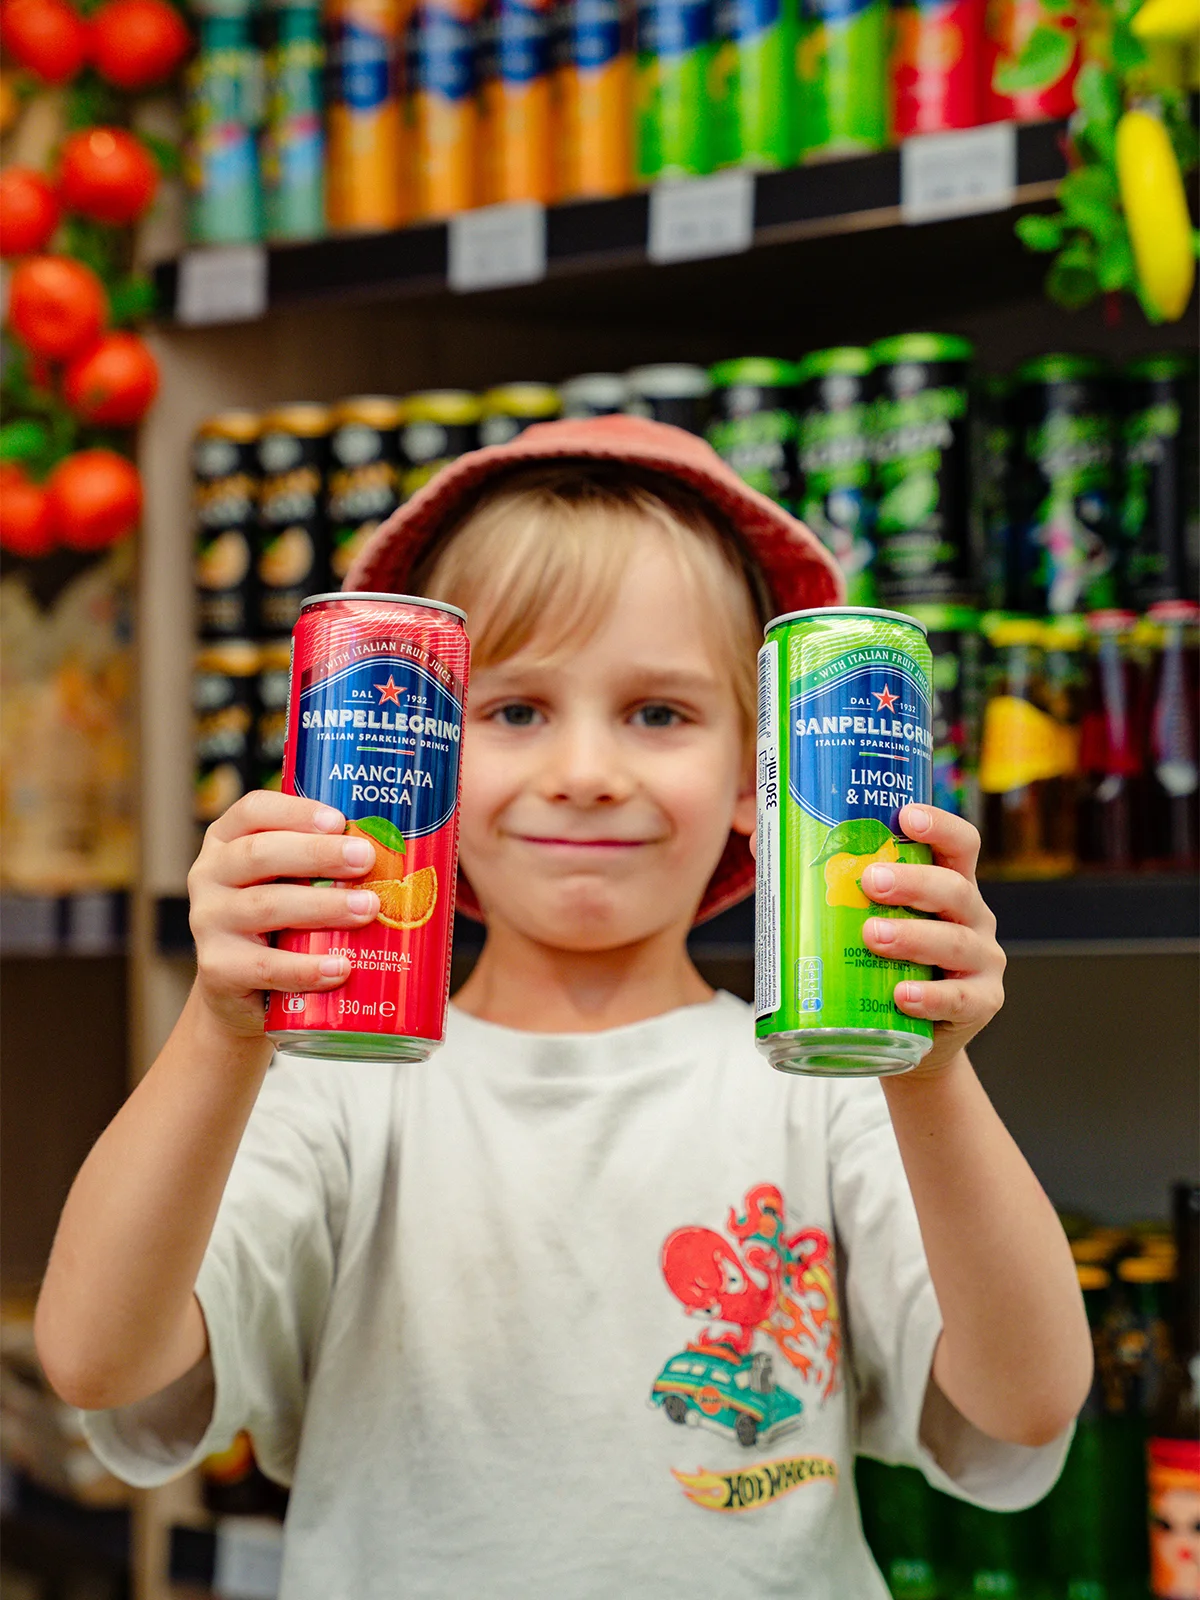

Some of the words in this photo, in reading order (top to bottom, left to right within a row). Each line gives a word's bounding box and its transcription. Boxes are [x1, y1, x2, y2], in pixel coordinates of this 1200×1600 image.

[324, 653, 351, 671] WITH
[352, 641, 397, 658] ITALIAN
[400, 644, 430, 663] FRUIT
[428, 657, 452, 685] JUICE
[819, 660, 846, 680] WITH
[847, 650, 889, 666] ITALIAN
[891, 653, 916, 672] FRUIT
[351, 688, 373, 698] DAL
[406, 694, 428, 705] 1932
[850, 697, 871, 705] DAL
[899, 702, 916, 713] 1932
[302, 709, 461, 743] SANPELLEGRINO
[795, 716, 933, 751] SANPELLEGRIN
[317, 732, 354, 741] ITALIAN
[359, 733, 416, 746] SPARKLING
[420, 740, 450, 753] DRINKS
[815, 738, 855, 747] ITALIAN
[860, 739, 910, 753] SPARKLING
[328, 763, 434, 789] ARANCIATA
[765, 761, 777, 780] ml
[850, 768, 914, 792] LIMONE
[351, 784, 412, 806] ROSSA
[765, 782, 777, 810] 330
[846, 791, 859, 804] &
[360, 949, 412, 964] NATURAL
[843, 947, 872, 958] 100%
[350, 960, 402, 972] GREDIENTS
[855, 959, 910, 973] INGREDIENTS
[292, 1000, 299, 1009] E
[338, 999, 360, 1015] 330
[362, 1001, 377, 1016] ml
[724, 1474, 763, 1508] HOT
